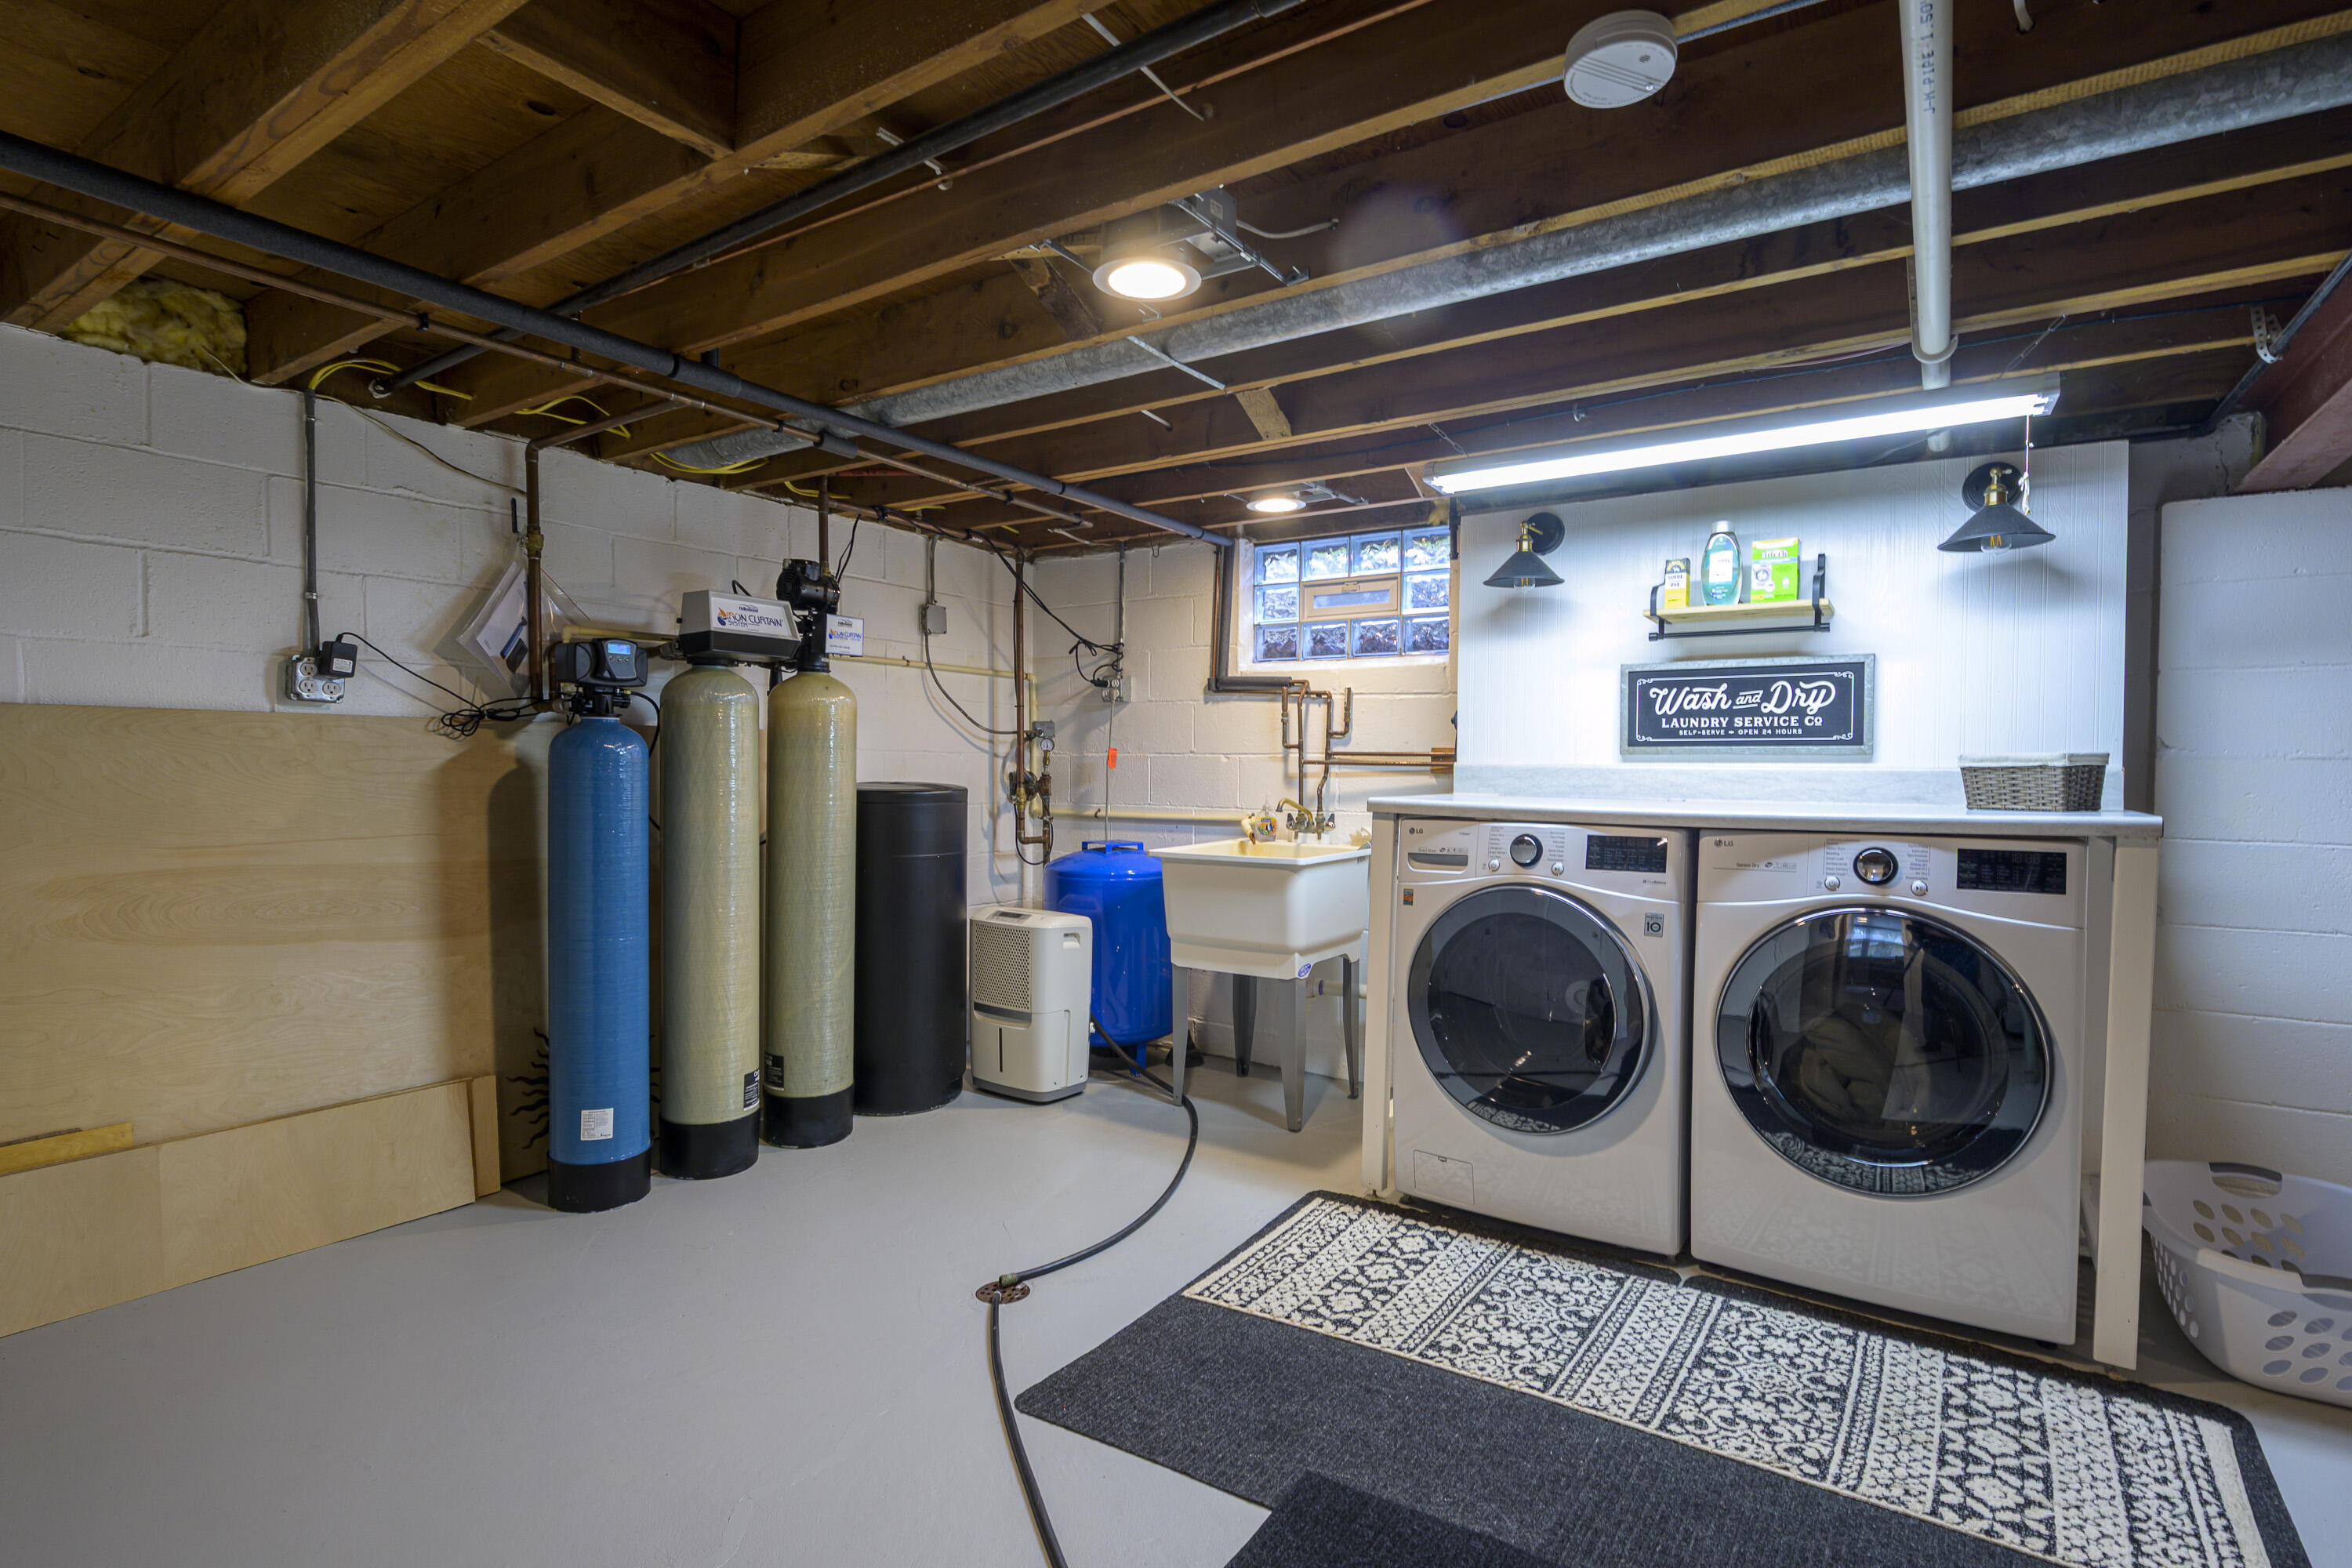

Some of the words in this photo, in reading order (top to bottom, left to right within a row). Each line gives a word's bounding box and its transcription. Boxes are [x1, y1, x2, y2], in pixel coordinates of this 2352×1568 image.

[1650, 683, 1732, 715] Wash
[1734, 690, 1764, 707] and
[1761, 681, 1836, 715] Dry
[1661, 717, 1730, 728] LAUNDRY
[1733, 715, 1800, 728] SERVICE
